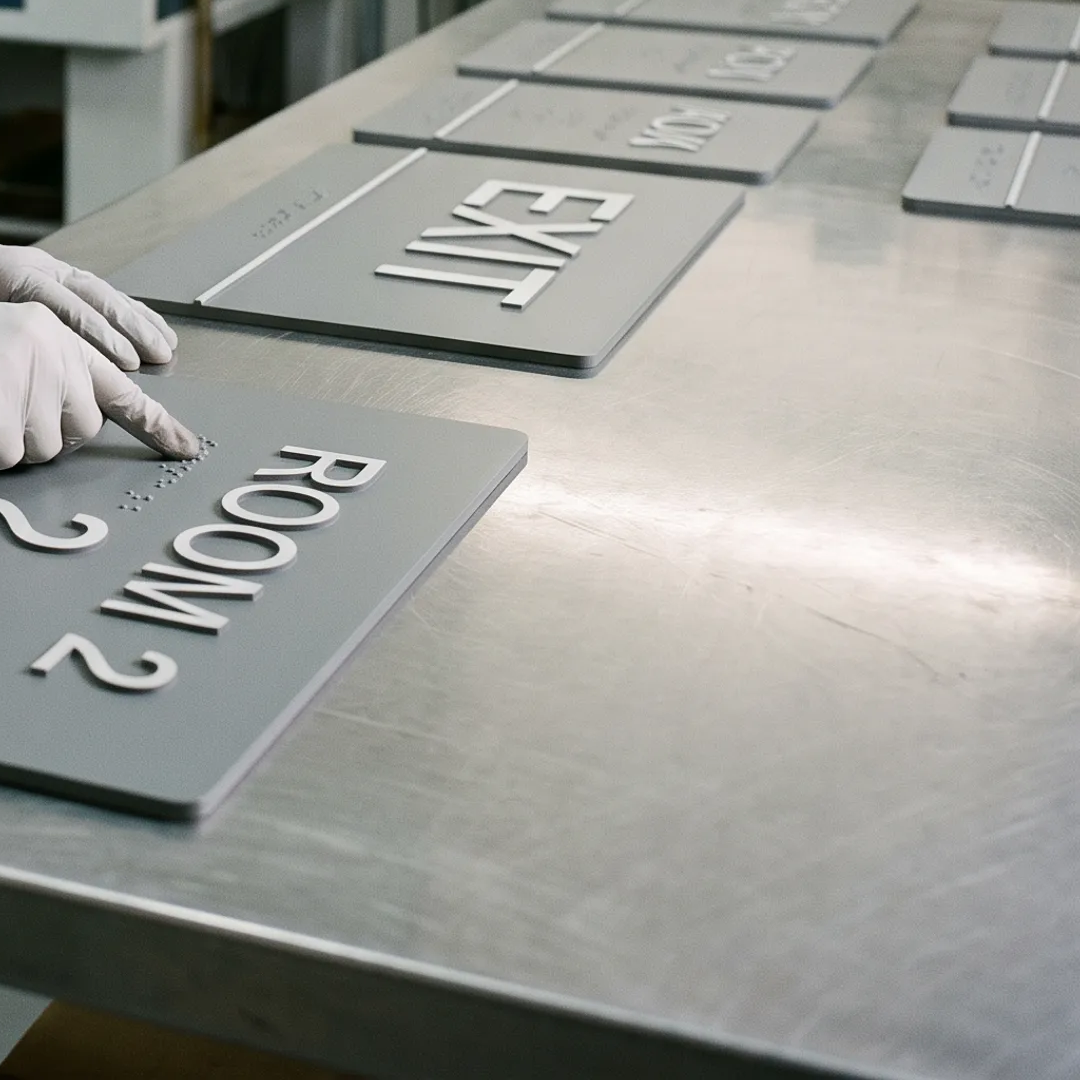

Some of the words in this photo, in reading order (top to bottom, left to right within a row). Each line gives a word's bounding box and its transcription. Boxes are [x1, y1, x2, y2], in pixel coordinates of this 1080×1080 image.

[374, 179, 635, 309] EXIT
[99, 443, 389, 635] ROOM
[30, 631, 179, 693] 2
